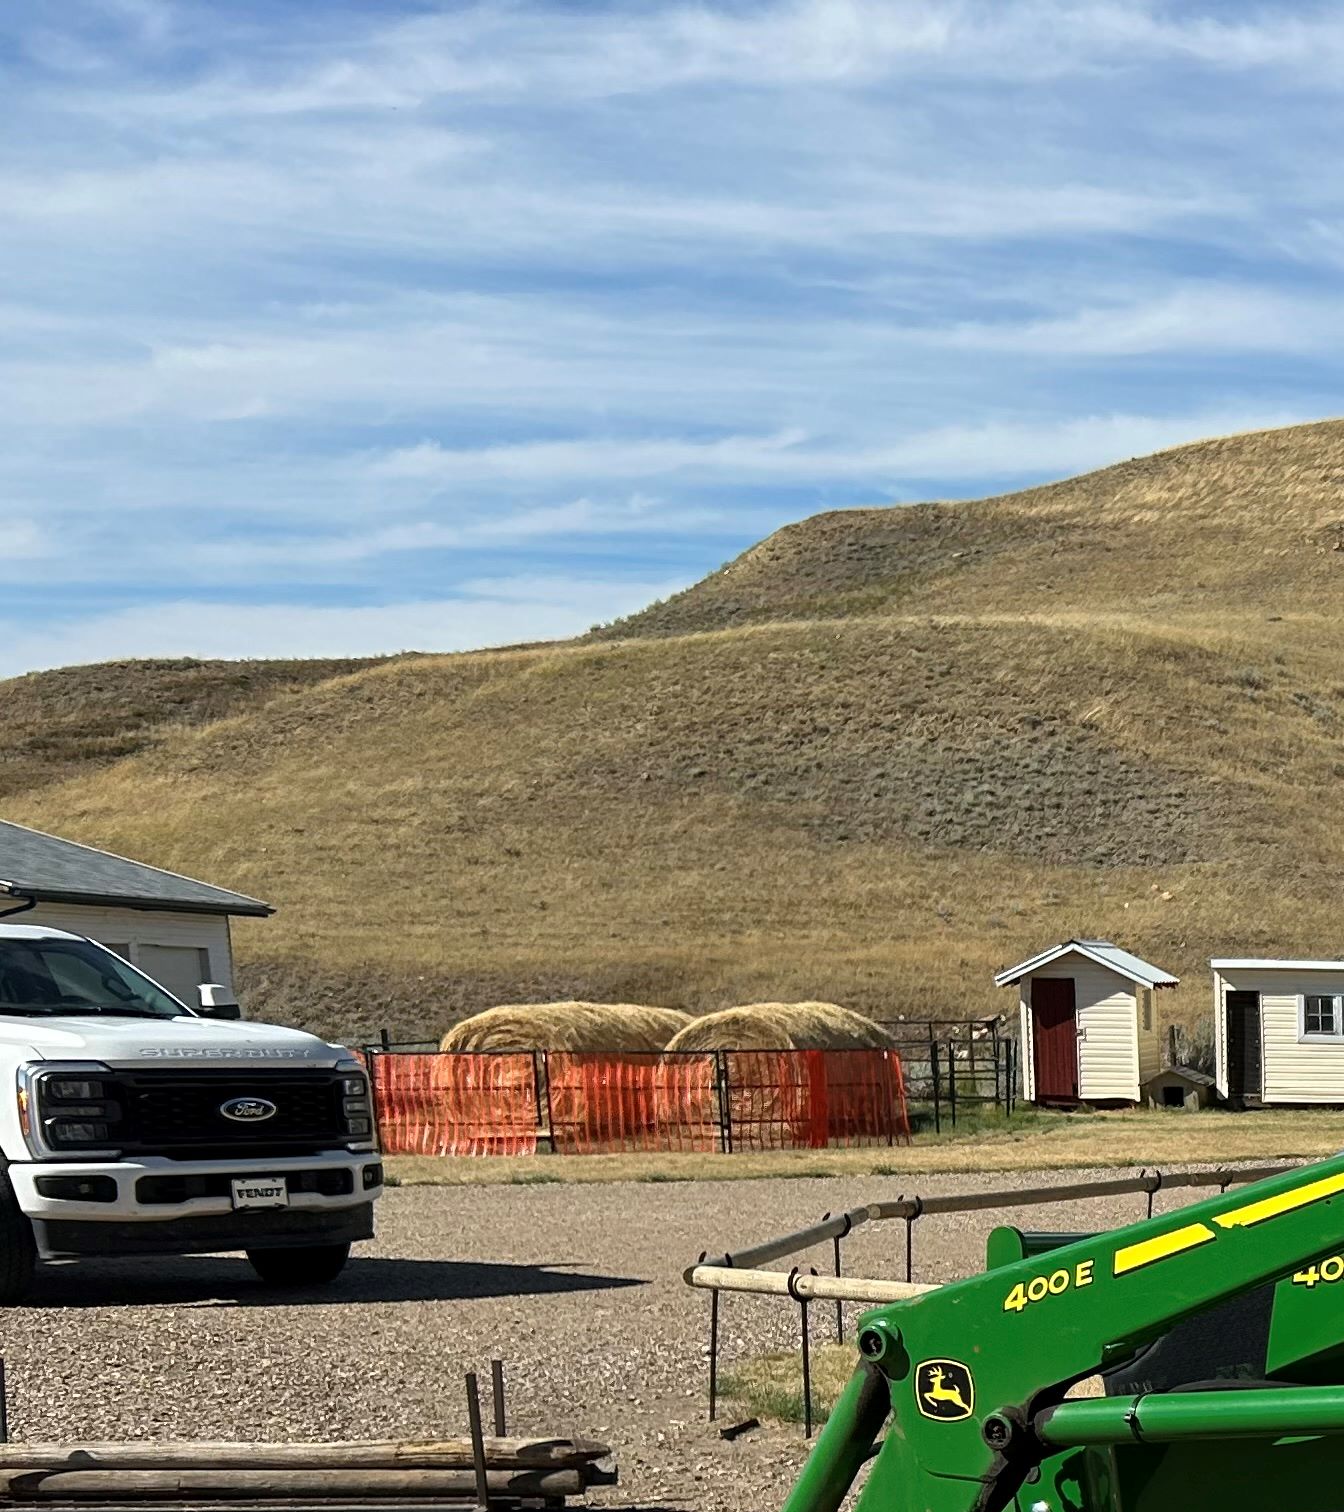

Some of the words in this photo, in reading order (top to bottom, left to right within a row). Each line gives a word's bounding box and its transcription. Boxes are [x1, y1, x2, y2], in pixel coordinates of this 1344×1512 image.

[139, 1048, 242, 1058] SUPER
[245, 1048, 310, 1058] DUTY
[236, 1186, 284, 1199] FENDT
[1004, 1269, 1070, 1312] 400
[1075, 1259, 1095, 1288] E
